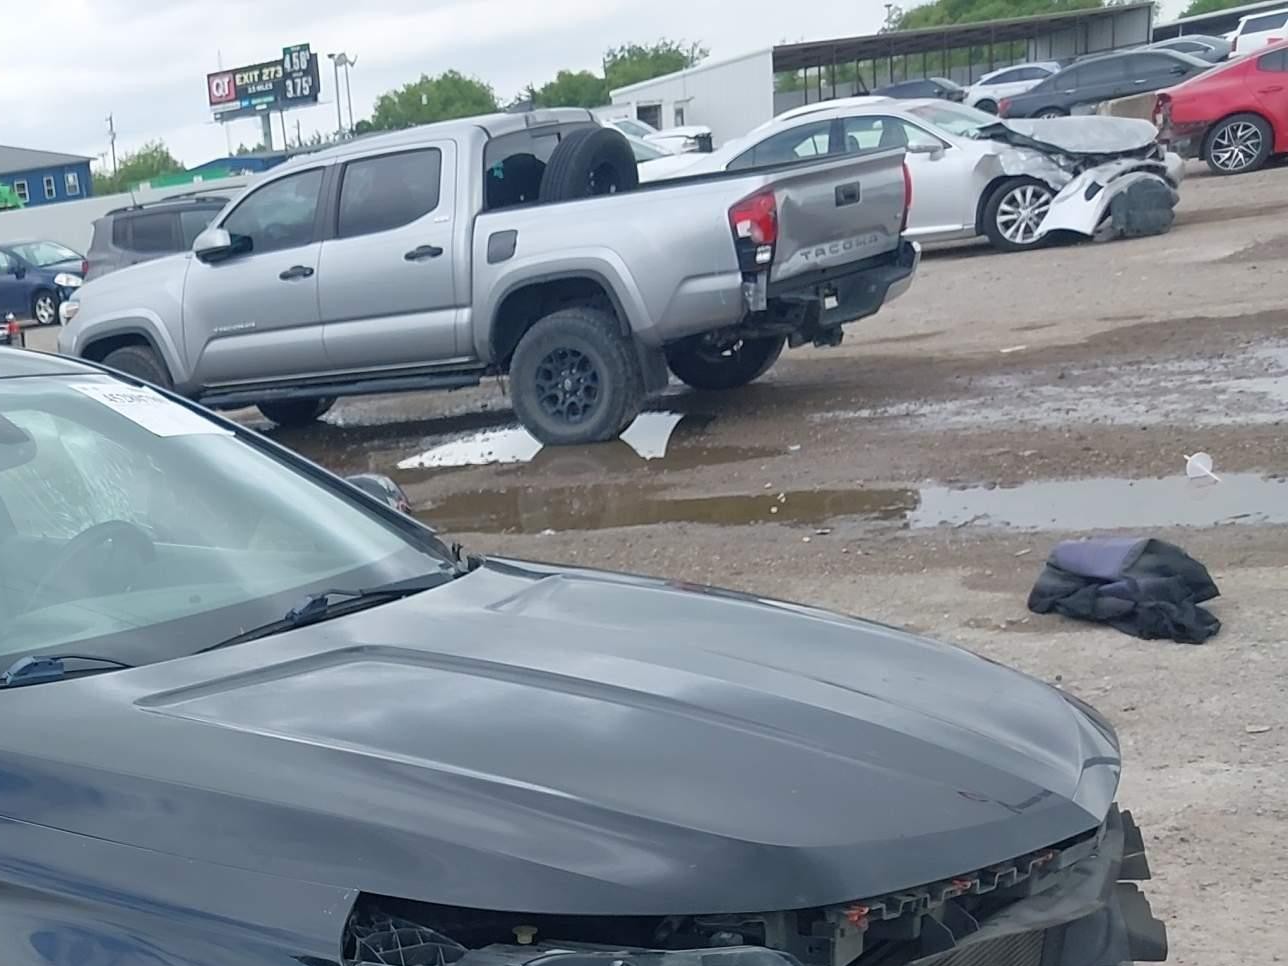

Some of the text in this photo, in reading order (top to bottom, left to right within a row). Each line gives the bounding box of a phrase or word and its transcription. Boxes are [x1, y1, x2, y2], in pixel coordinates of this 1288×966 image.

[235, 65, 283, 86] EXIT 273
[212, 77, 231, 98] QT
[799, 234, 878, 260] TACOMA
